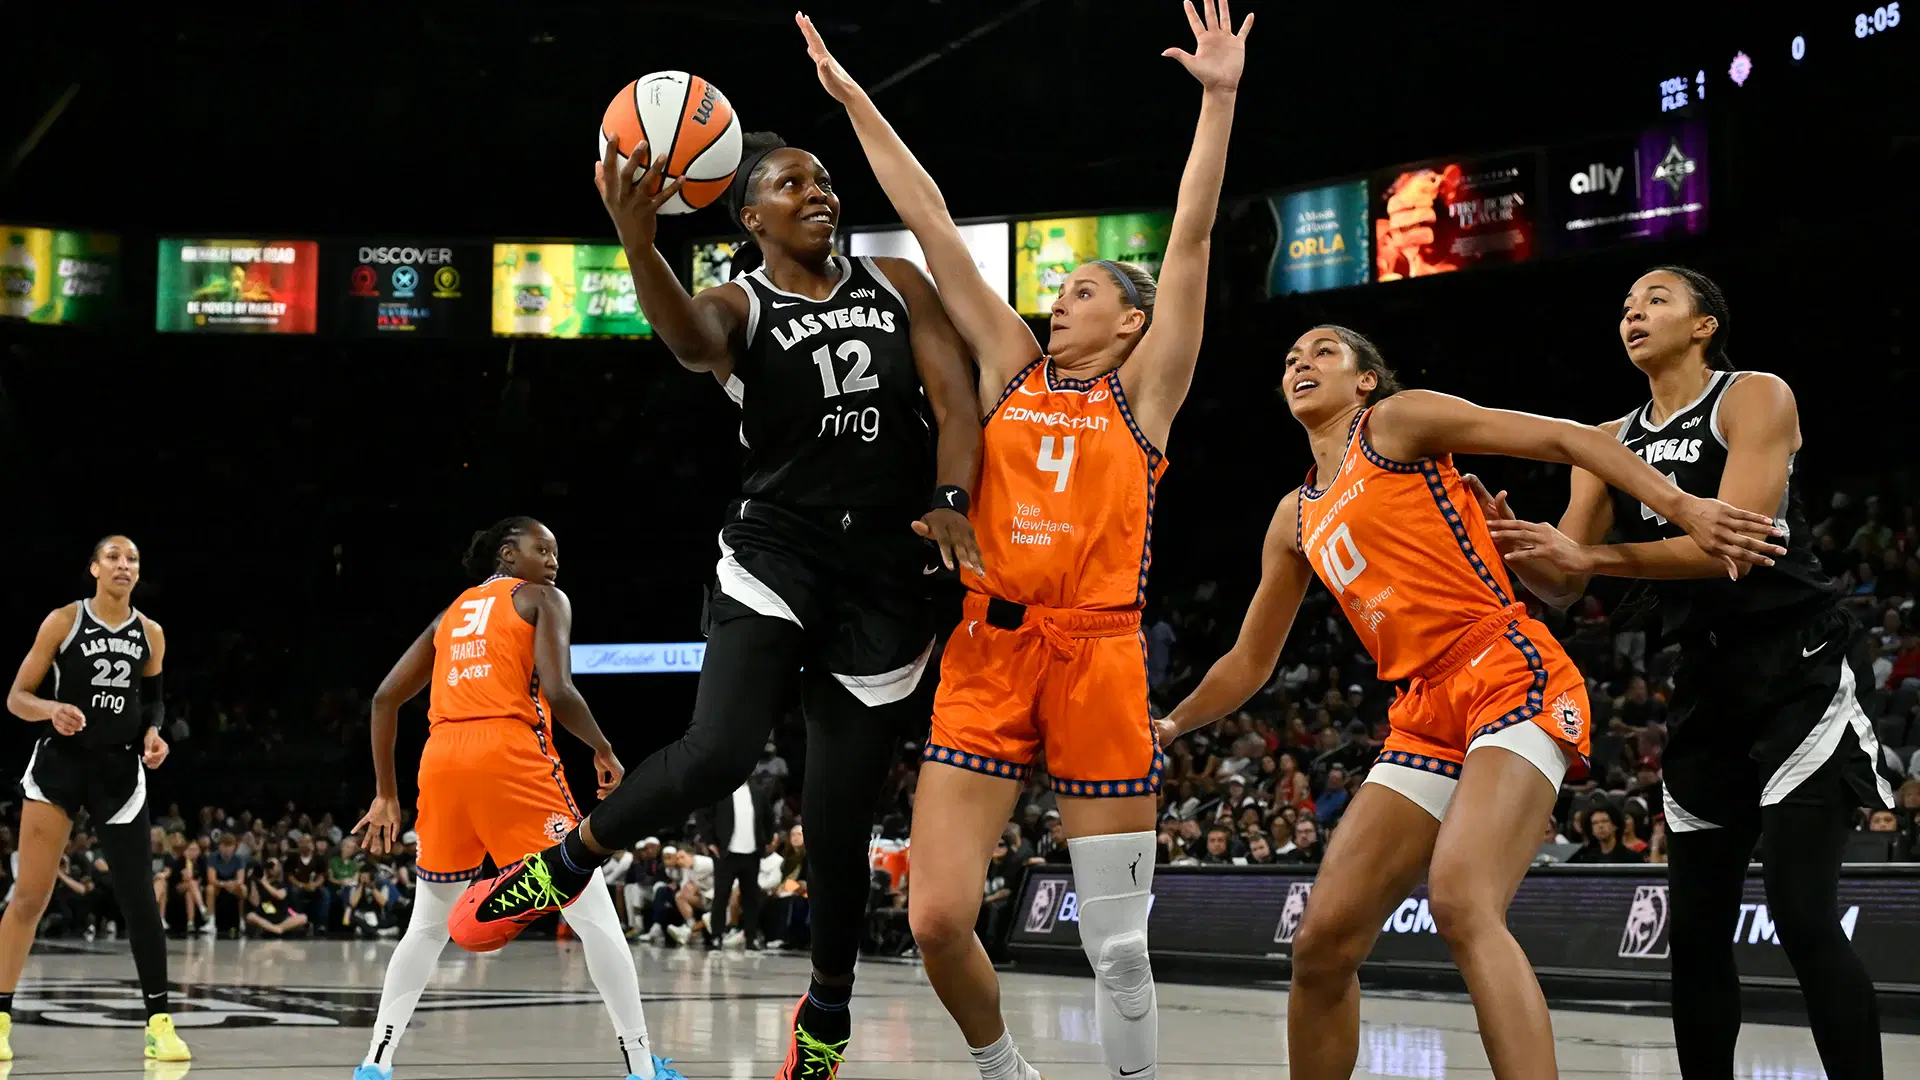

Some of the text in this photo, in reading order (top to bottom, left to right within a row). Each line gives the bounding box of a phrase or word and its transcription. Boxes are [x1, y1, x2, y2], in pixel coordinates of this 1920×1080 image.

[1855, 2, 1900, 38] 8:05
[1792, 36, 1805, 60] 0
[1660, 70, 1705, 96] TOL: 4
[1661, 85, 1705, 112] FLS: 1
[1570, 162, 1624, 195] ally
[1655, 160, 1696, 178] ACES
[358, 247, 453, 264] DISCOVER
[1289, 233, 1345, 259] ORLA
[582, 272, 635, 293] LEMO
[850, 288, 876, 299] ally
[770, 306, 896, 351] LAS VEGAS
[812, 339, 880, 398] 12
[817, 405, 880, 442] ring
[1002, 406, 1109, 432] CONNECTCUT
[1681, 415, 1703, 430] ally
[1036, 435, 1075, 492] 4
[1645, 438, 1703, 465] VEGAS
[1016, 502, 1041, 517] Yale
[1011, 531, 1052, 545] Health
[1012, 516, 1075, 536] NewHaven
[1319, 522, 1367, 595] 10
[451, 596, 496, 637] 31
[1360, 585, 1394, 624] NHaven
[80, 637, 143, 660] LAS VEGAS
[450, 639, 487, 661] HARLES
[664, 648, 703, 666] ULT
[91, 658, 132, 688] 22
[459, 664, 491, 679] AT&T
[91, 691, 125, 714] ring
